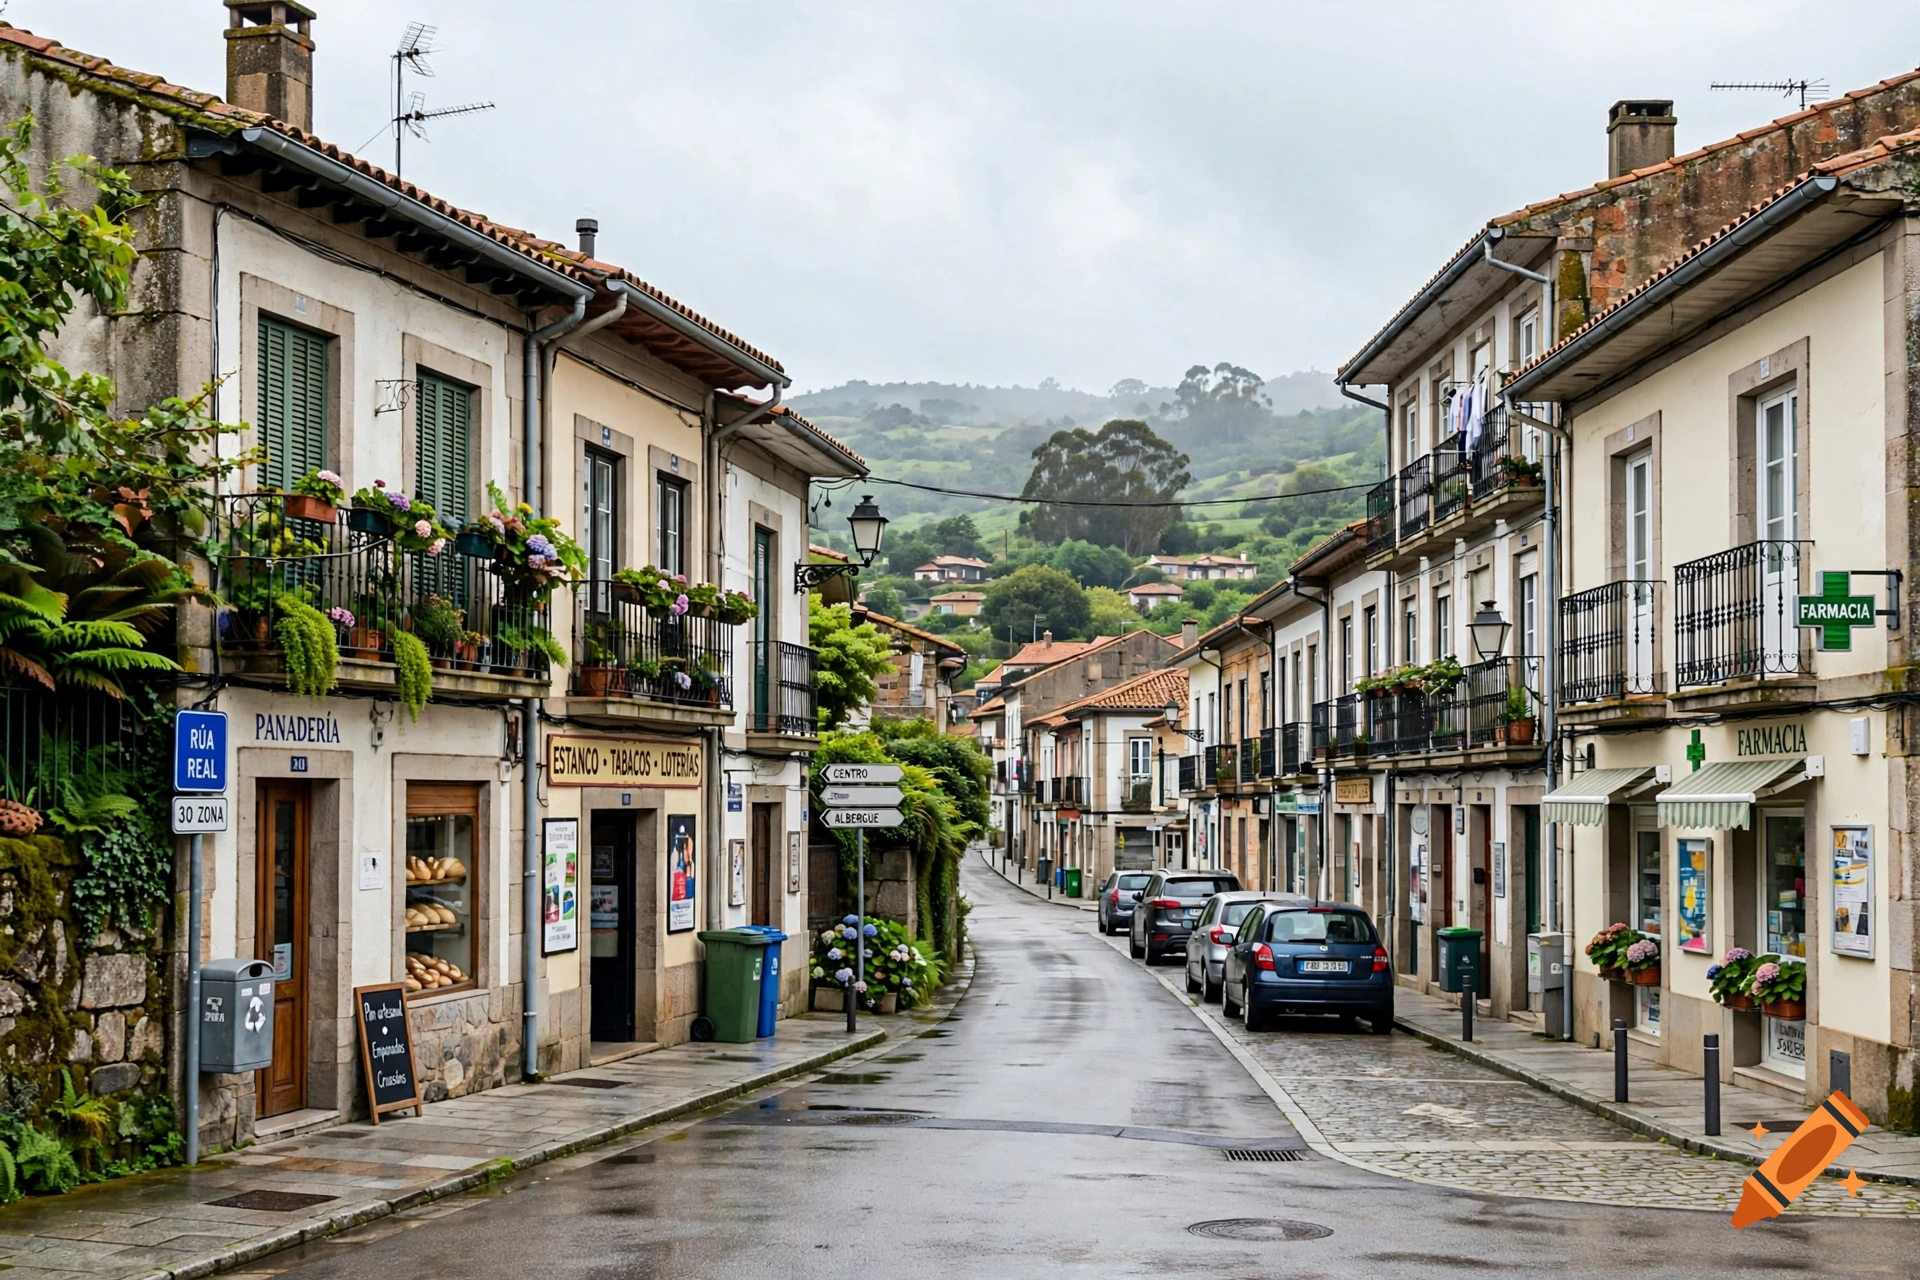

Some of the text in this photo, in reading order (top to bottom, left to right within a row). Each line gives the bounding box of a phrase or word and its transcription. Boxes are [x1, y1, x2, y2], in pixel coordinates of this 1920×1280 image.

[1801, 603, 1870, 619] FARMACIA
[190, 724, 215, 750] RÚA
[255, 711, 340, 744] PANADERÍA
[1737, 724, 1808, 756] FARMACIA
[187, 758, 218, 779] REAL
[553, 746, 699, 777] ESTANCO TABACOS LOTERÍAS
[833, 768, 868, 779] CENTRO
[178, 806, 224, 824] 30 ZONA
[834, 812, 879, 824] ALBERGUE
